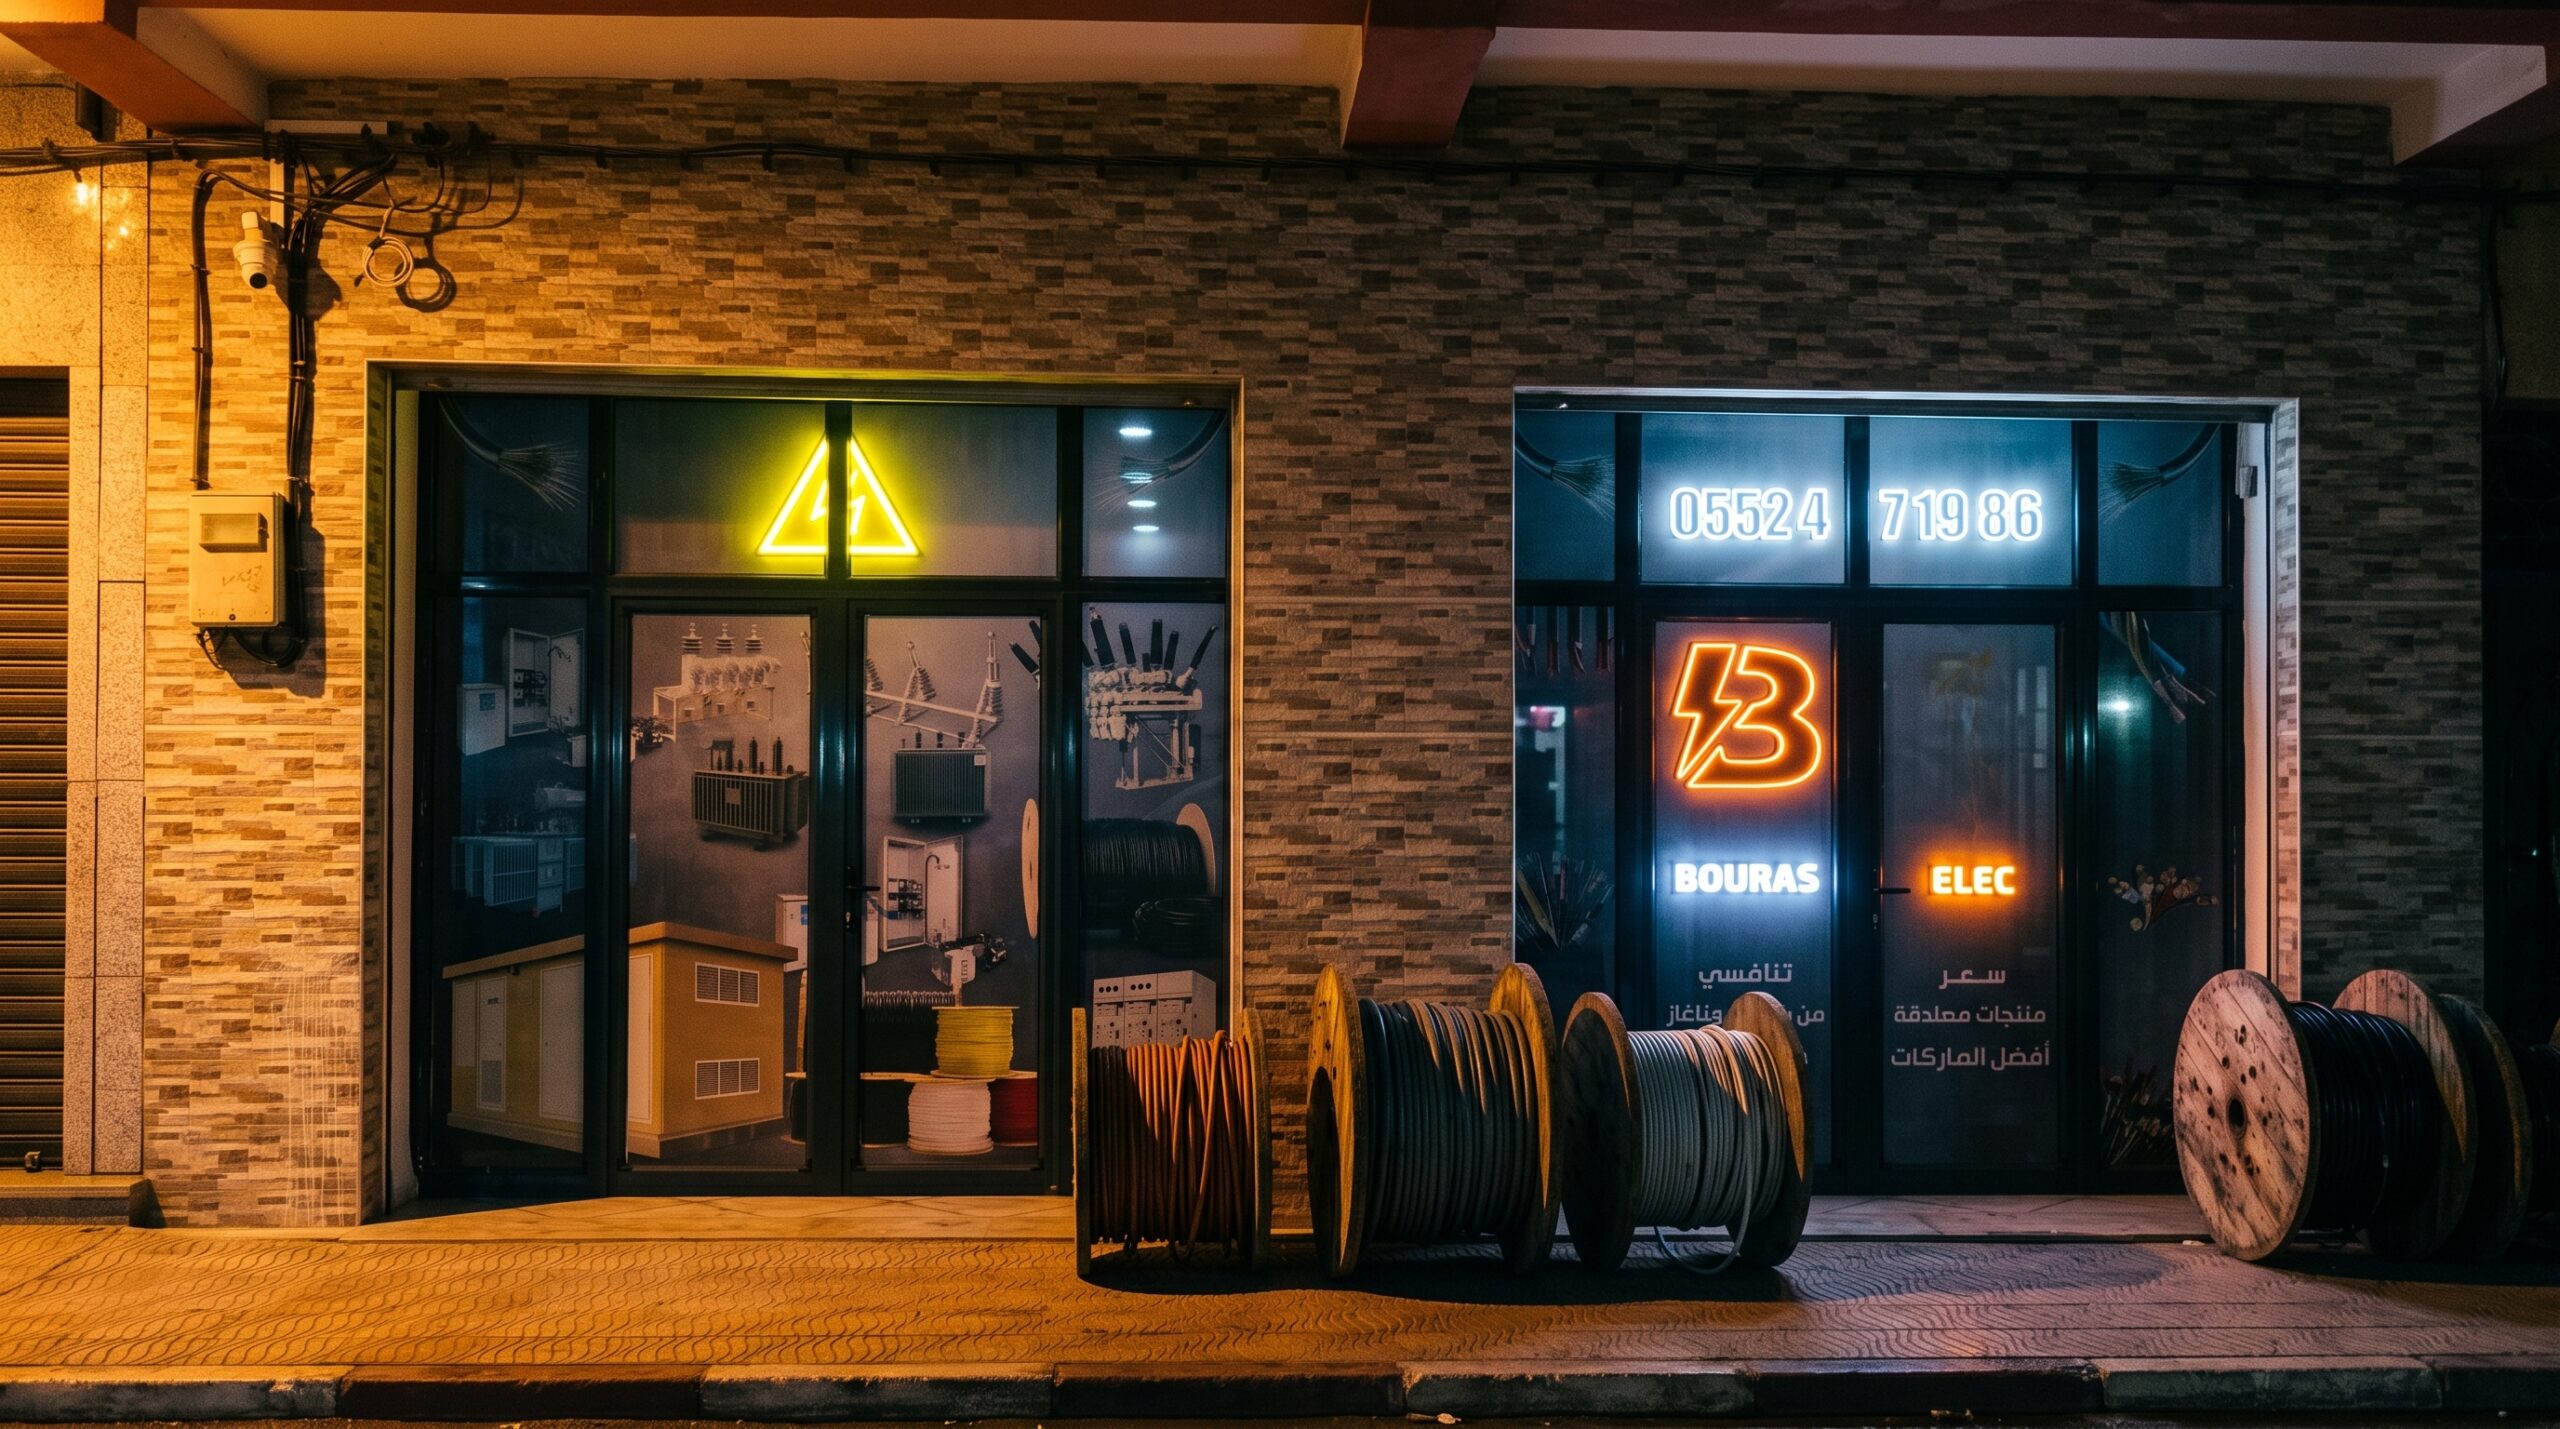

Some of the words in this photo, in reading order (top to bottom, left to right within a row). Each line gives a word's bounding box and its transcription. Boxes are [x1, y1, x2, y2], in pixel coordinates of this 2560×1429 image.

[1673, 862, 1821, 894] BOURAS
[1930, 865, 2016, 895] ELEC
[1698, 963, 1793, 990] تنافسي
[1938, 969, 2007, 990] سعر
[1796, 1005, 1826, 1027] من
[1890, 1046, 1986, 1072] الماركات
[1990, 1040, 2051, 1071] أفضل
